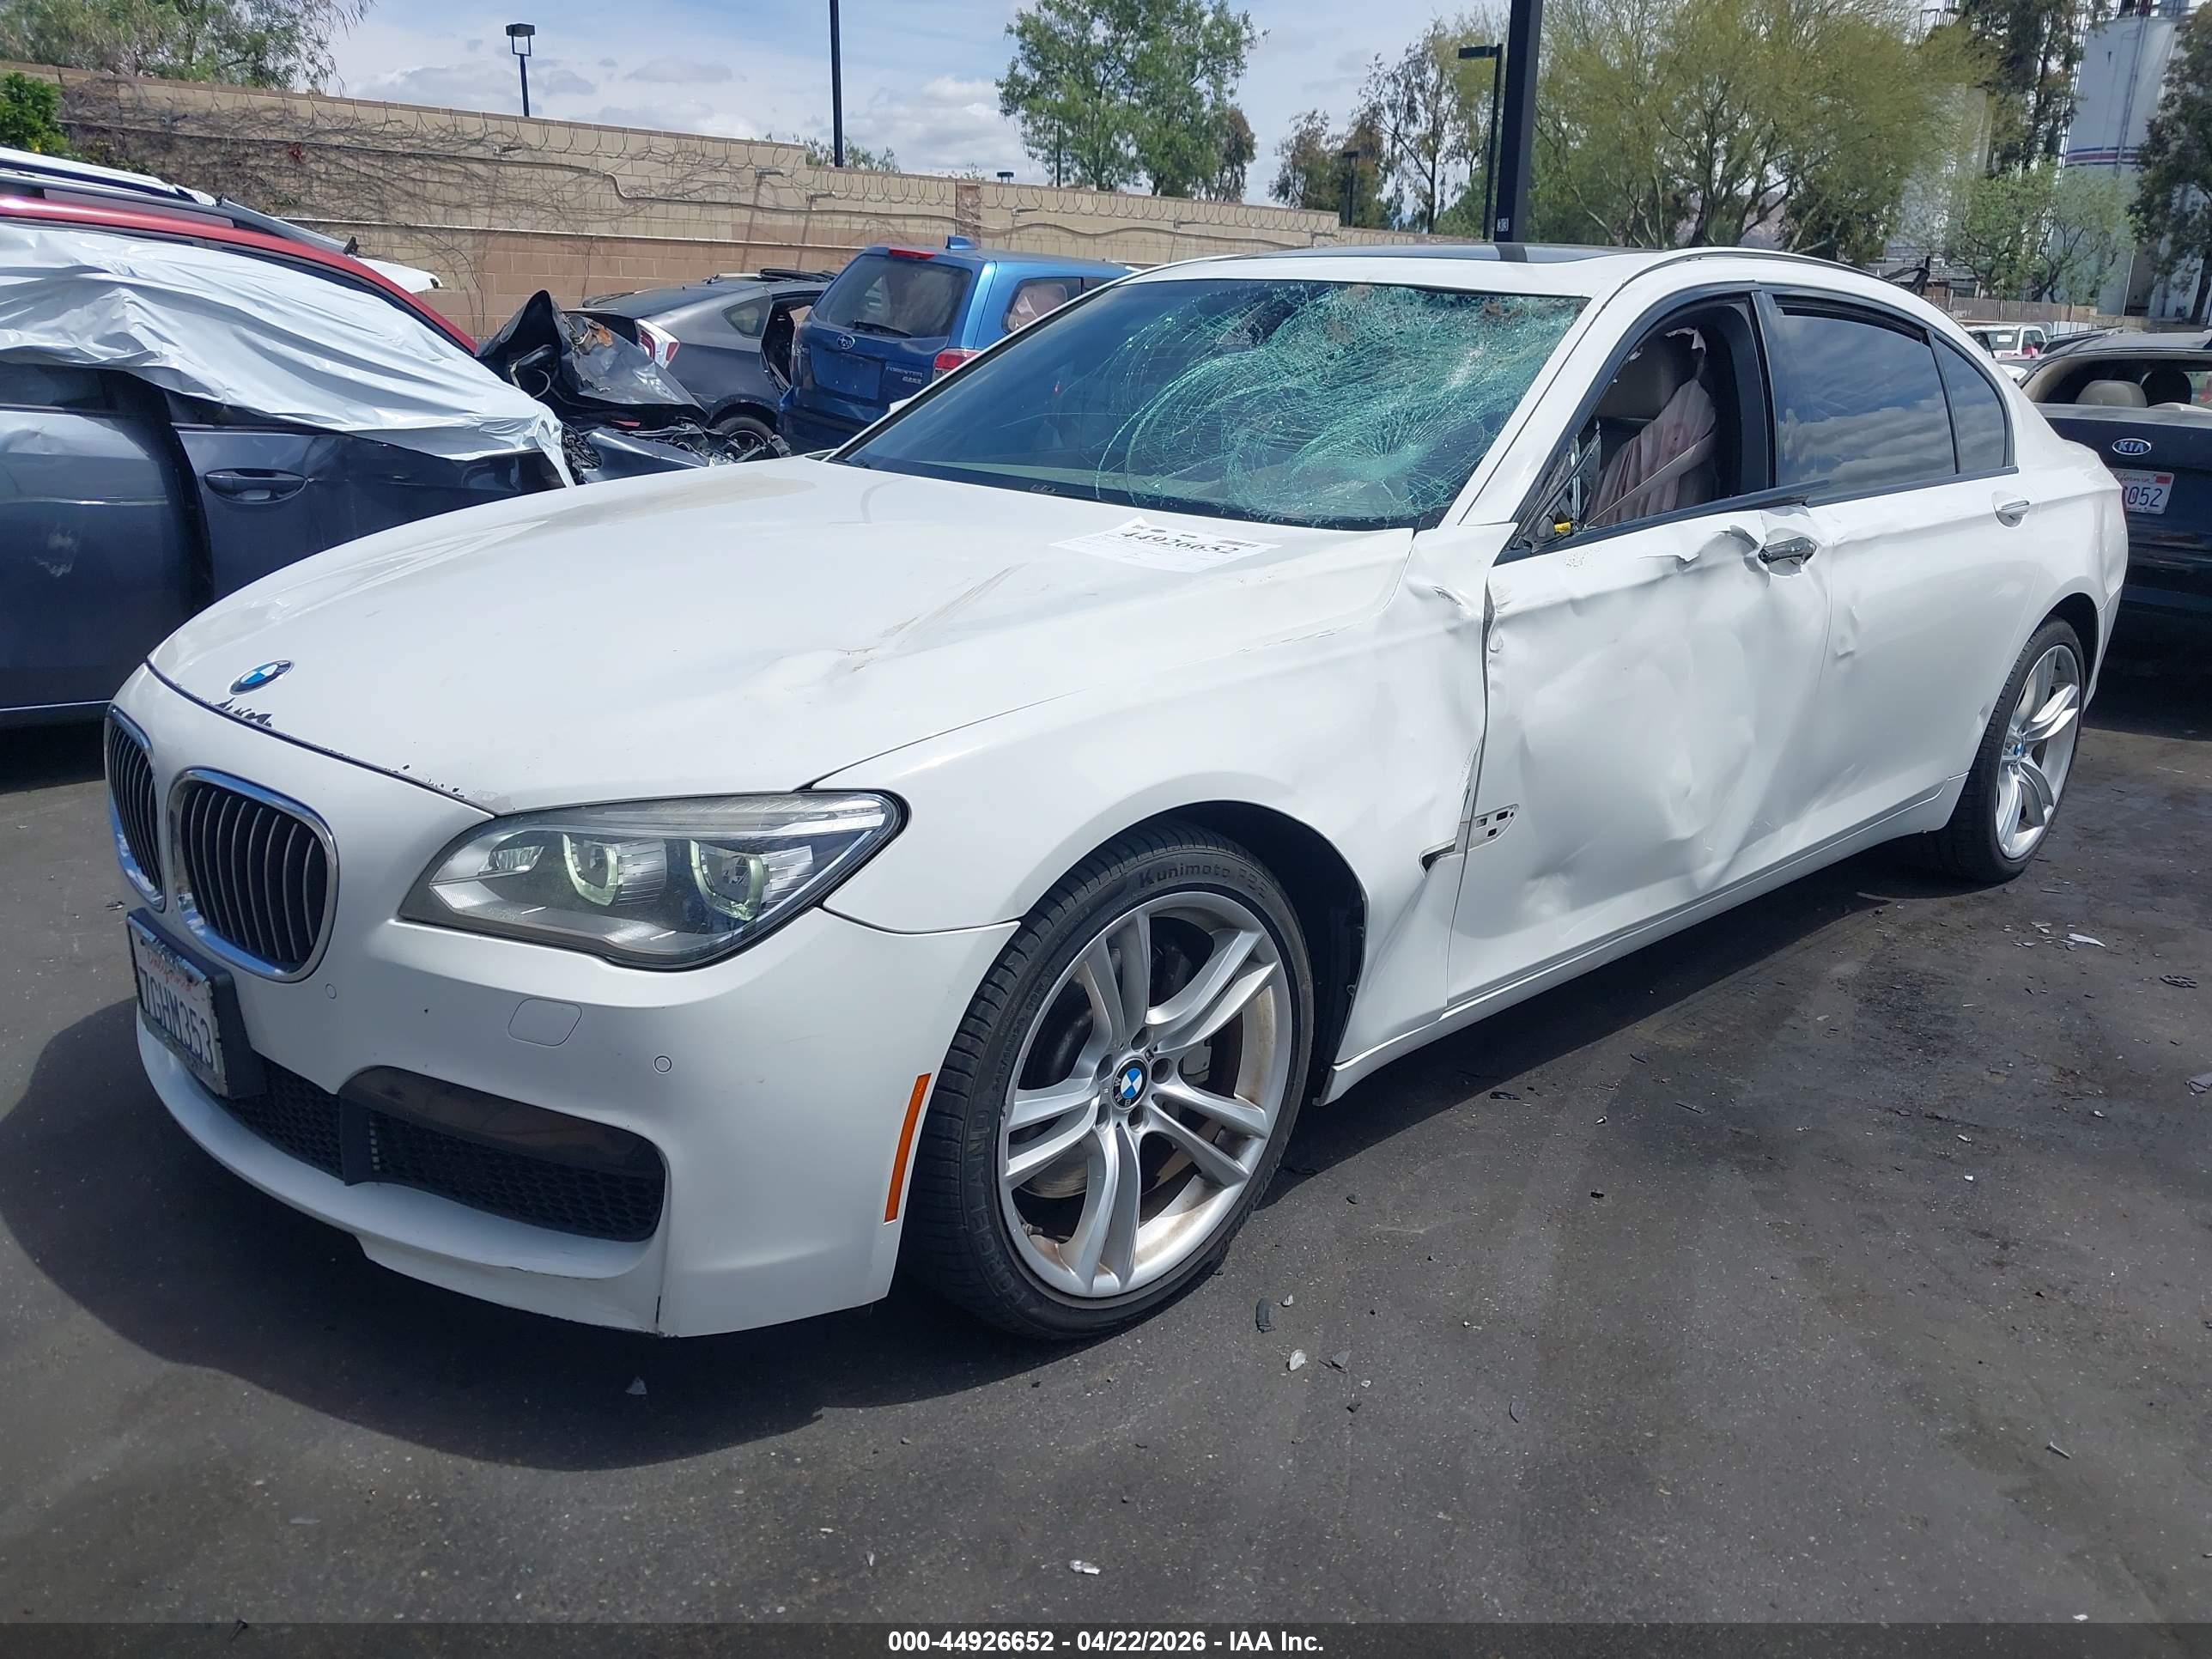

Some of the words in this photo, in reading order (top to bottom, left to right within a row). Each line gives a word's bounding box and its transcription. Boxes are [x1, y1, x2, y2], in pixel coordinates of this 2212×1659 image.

[2118, 441, 2144, 453] KIA
[1139, 862, 1231, 888] Kunimoto
[137, 966, 215, 1066] 7GHM353
